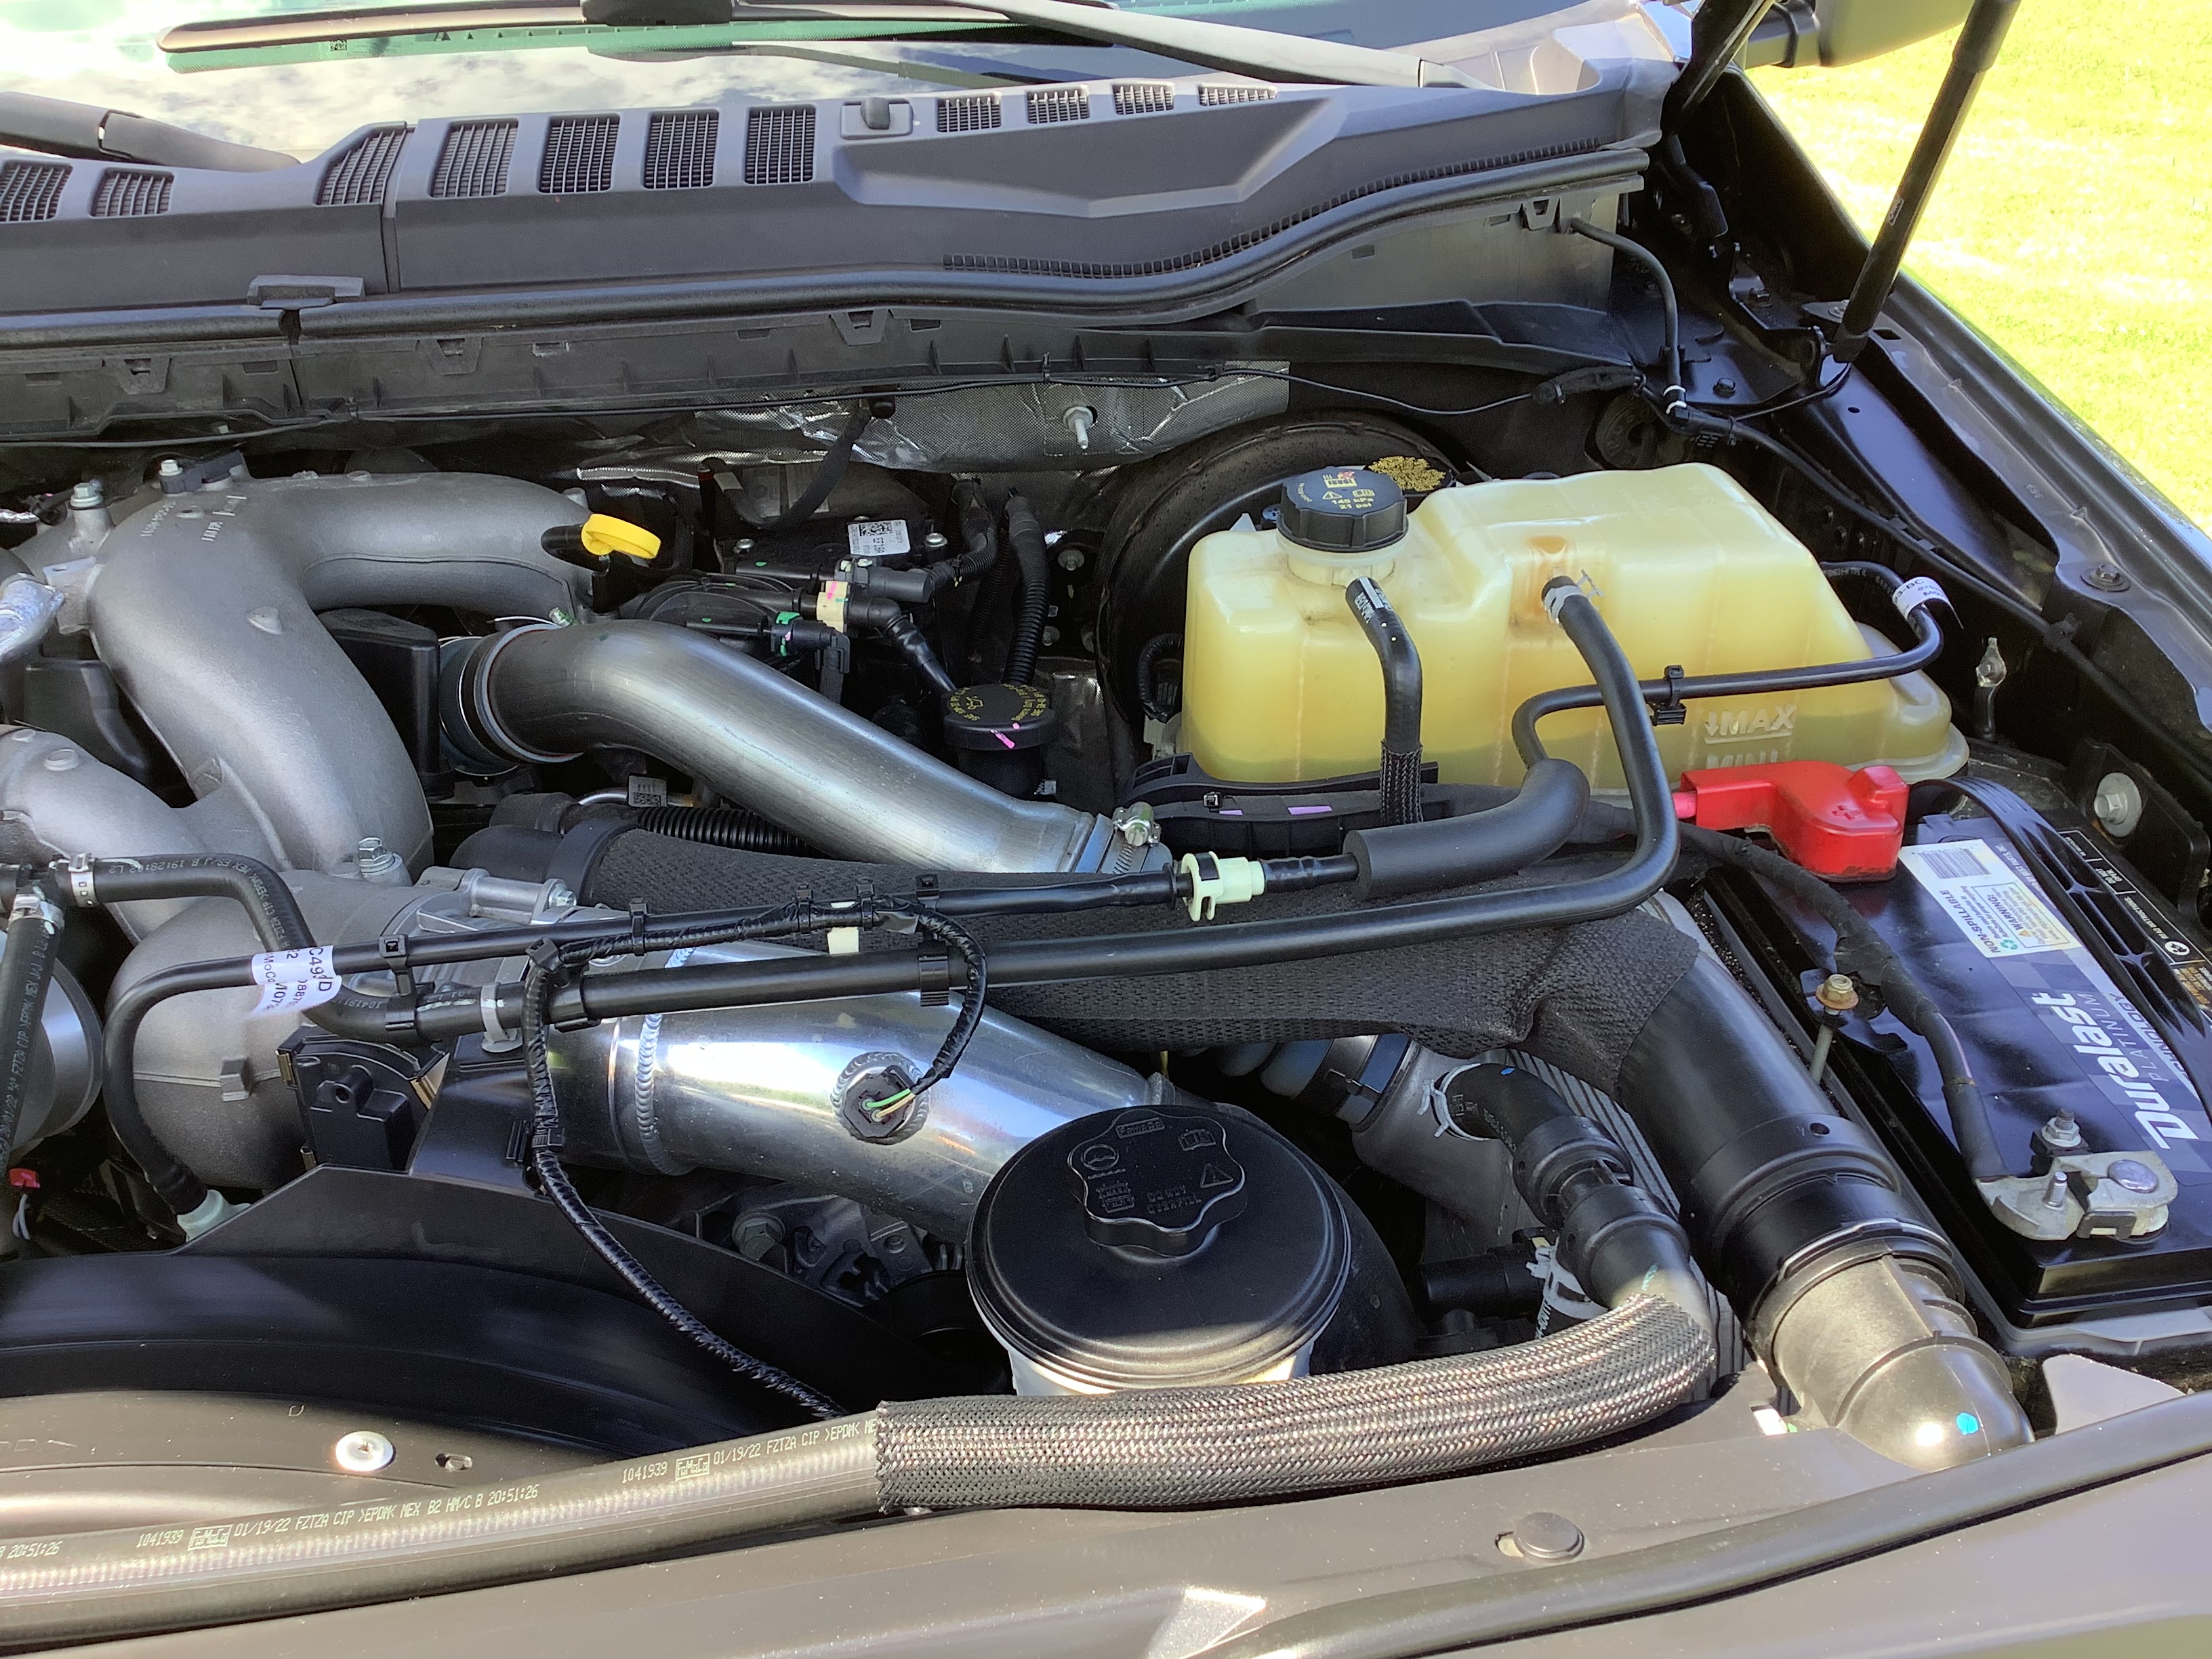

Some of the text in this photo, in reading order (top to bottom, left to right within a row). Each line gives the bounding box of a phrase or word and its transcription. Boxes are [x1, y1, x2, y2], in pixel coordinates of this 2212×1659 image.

[1719, 704, 1798, 736] MAX
[1939, 889, 2001, 953] NON-SPILLABLE
[1984, 894, 2025, 930] WARNING:
[2076, 993, 2169, 1082] PLATINUM
[2032, 992, 2198, 1149] Duralast
[621, 1460, 668, 1483] 1041939
[713, 1442, 762, 1465] 01/19/22
[766, 1435, 797, 1455] FZTZA
[801, 1429, 820, 1446] CIP
[136, 1529, 184, 1549] 1041939
[234, 1517, 292, 1537] 01/19/22
[295, 1513, 330, 1530] FZTZA
[333, 1509, 355, 1527] CIP
[400, 1501, 422, 1519] MEX
[428, 1498, 442, 1515] B2
[474, 1493, 484, 1509] B
[487, 1483, 540, 1507] 20:51:26
[7, 1540, 63, 1559] 20:51:26
